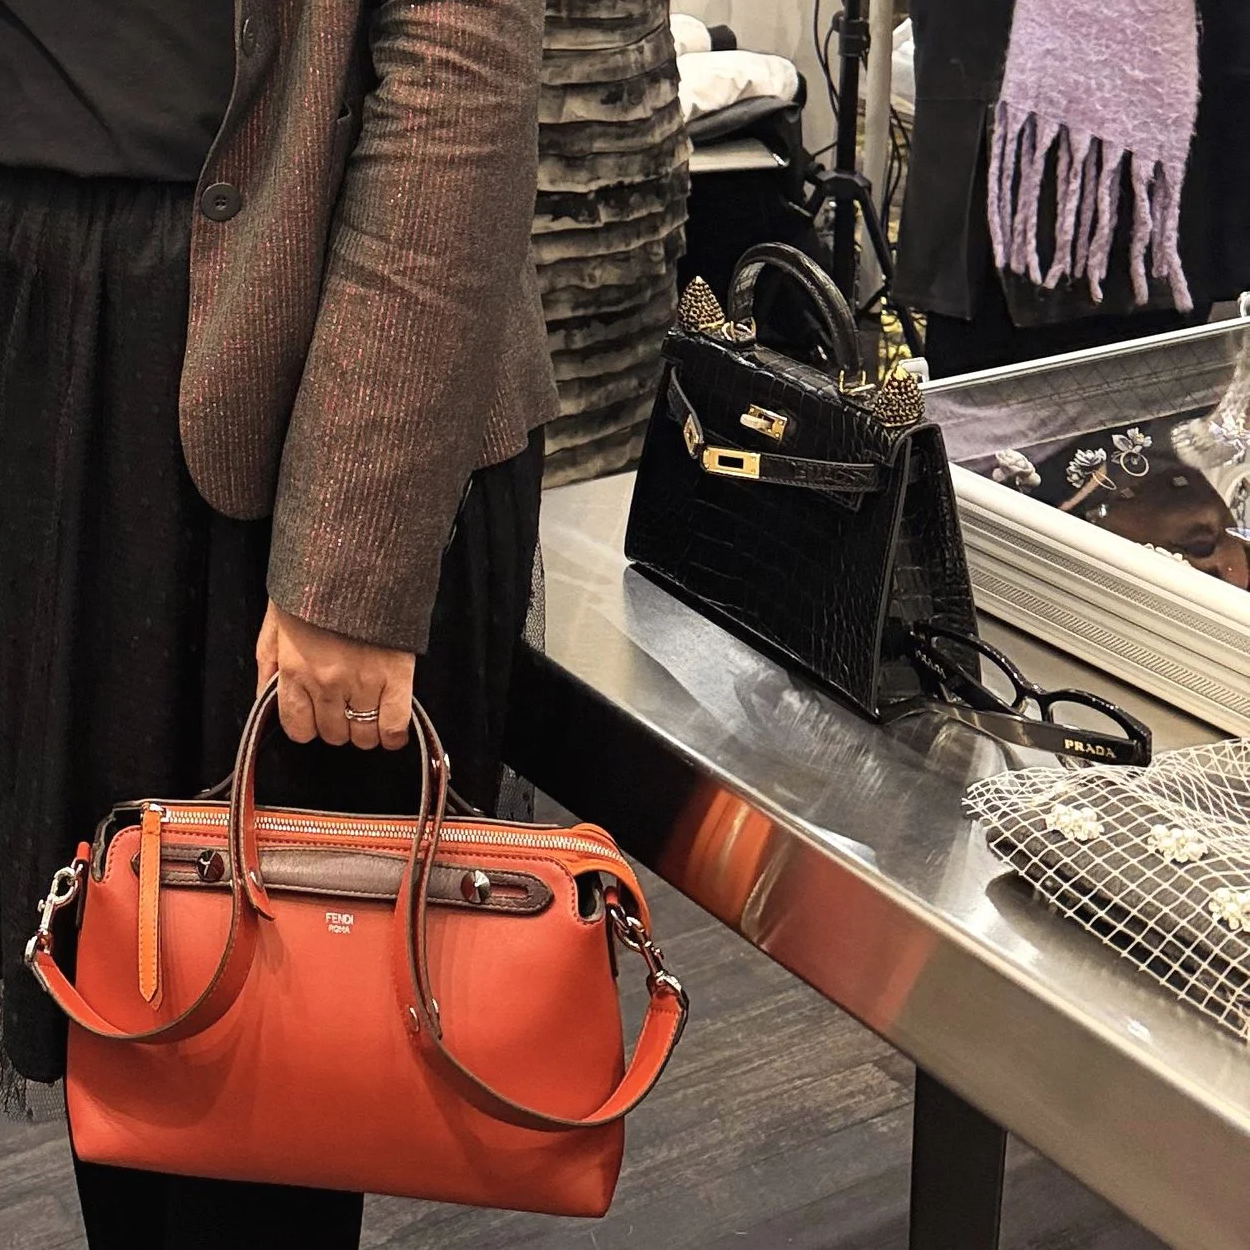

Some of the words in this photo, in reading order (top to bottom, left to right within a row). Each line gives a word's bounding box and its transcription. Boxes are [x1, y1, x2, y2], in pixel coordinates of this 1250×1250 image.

[1064, 738, 1117, 760] PRADA
[325, 912, 354, 925] FENDI
[327, 923, 351, 935] ROMA
